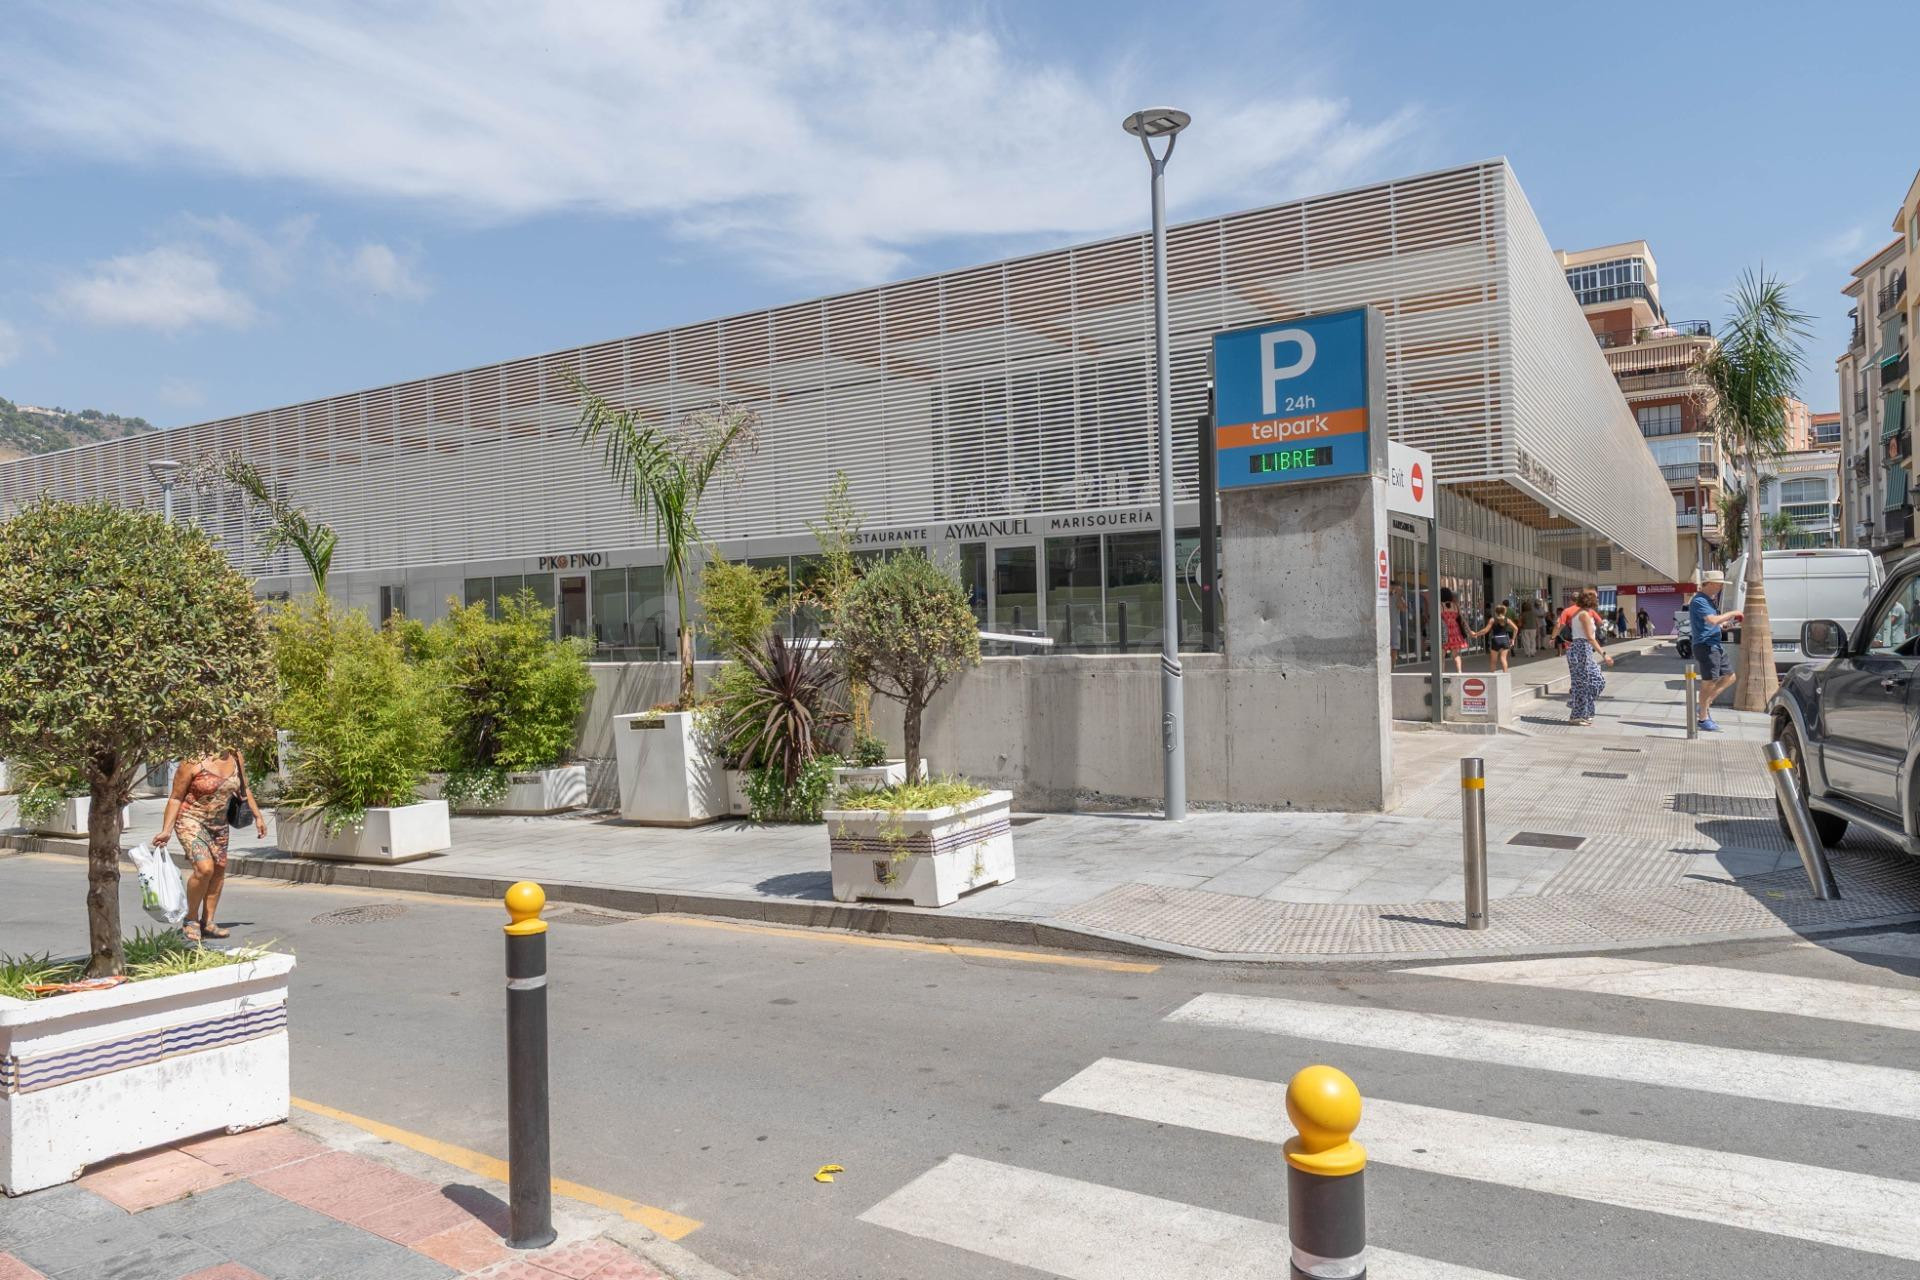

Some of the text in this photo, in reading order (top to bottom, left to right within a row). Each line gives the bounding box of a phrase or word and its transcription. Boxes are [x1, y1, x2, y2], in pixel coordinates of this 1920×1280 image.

[1260, 328, 1317, 415] P
[1285, 395, 1315, 412] 24h
[1251, 415, 1329, 441] telpark
[1261, 448, 1317, 472] LIBRE
[1391, 467, 1405, 488] Exit
[849, 509, 1154, 545] ESTAURANTE AYMANUEL MARISQUERÍA
[570, 552, 602, 568] FINO
